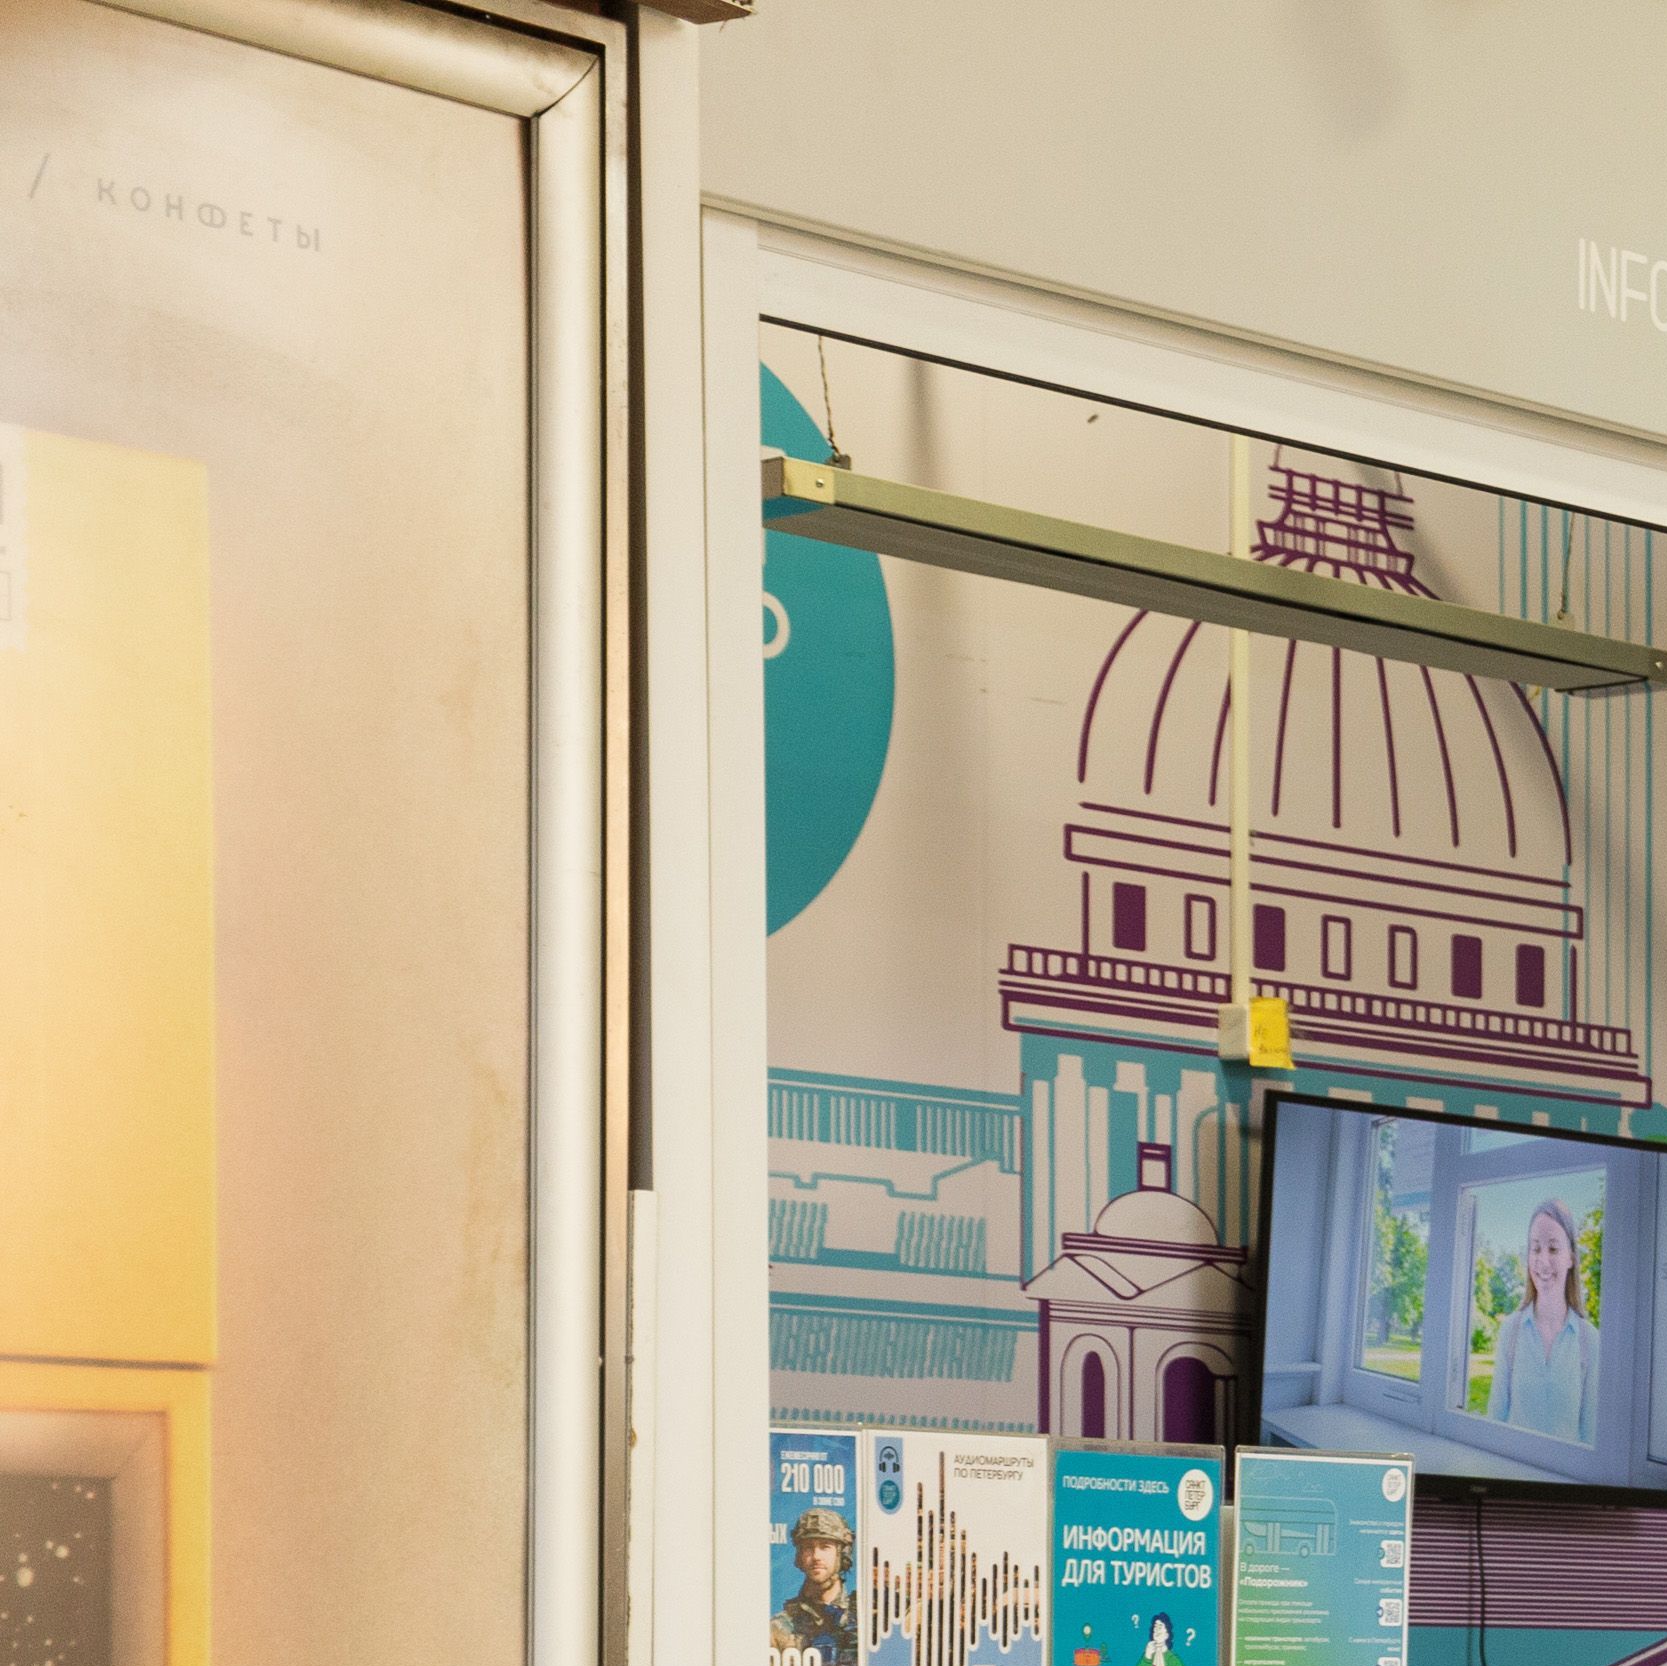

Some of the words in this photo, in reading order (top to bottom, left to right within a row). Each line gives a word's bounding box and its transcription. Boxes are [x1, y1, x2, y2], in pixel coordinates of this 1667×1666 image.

[97, 177, 320, 251] КОНФЕТЫ
[953, 1454, 1034, 1468] АУДИОМАРШРУТЫ
[953, 1467, 968, 1478] ПО
[970, 1468, 1023, 1481] ПЕТЕРБУРГУ
[780, 1462, 810, 1493] 210
[813, 1463, 845, 1494] 000
[1062, 1475, 1136, 1492] ПОДРОБНОСТИ
[1138, 1480, 1170, 1494] ЗДЕСЬ
[1063, 1524, 1206, 1558] ИНФОРМАЦИЯ
[1061, 1558, 1106, 1588] ДЛЯ
[1110, 1560, 1212, 1589] ТУРИСТОВ
